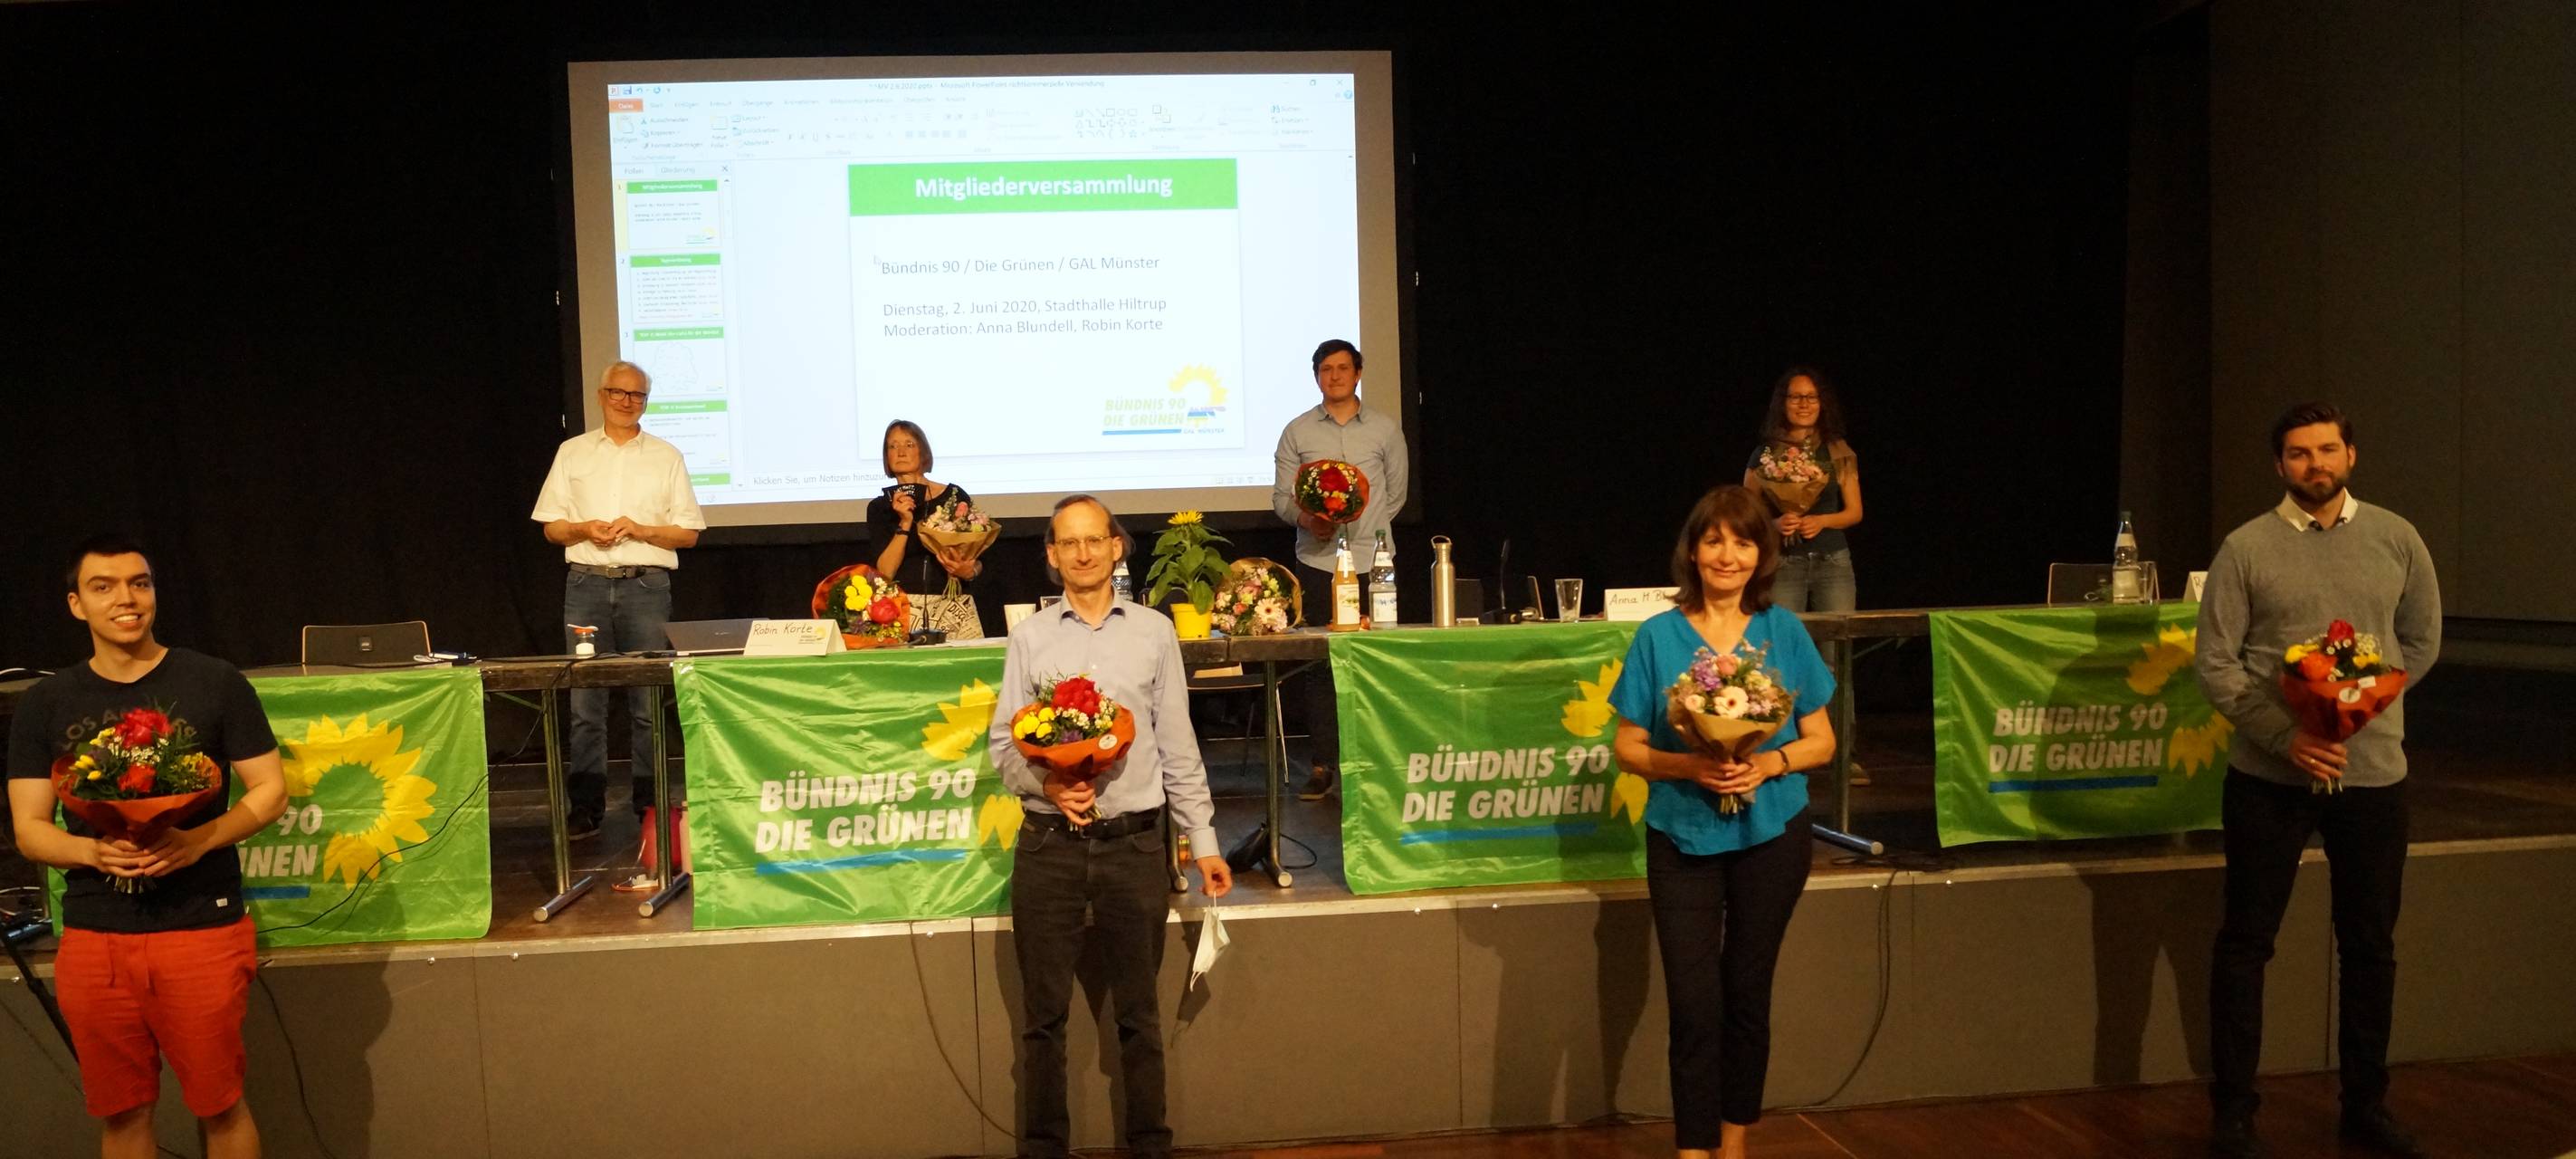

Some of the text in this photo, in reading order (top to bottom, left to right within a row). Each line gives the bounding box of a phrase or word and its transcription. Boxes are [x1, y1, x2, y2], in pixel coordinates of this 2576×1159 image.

[914, 174, 1173, 200] Mitgliederversammlung
[882, 255, 1160, 274] Bündnis 90 / Die Grünen / GAL Münster
[883, 298, 1167, 319] Dienstag, 2. Juni 2020, Stadthalle Hiltrup
[884, 318, 1164, 337] Moderation: Anna Blundell, Robin Korte
[1104, 397, 1187, 411] BÜNDNIS 90
[1102, 411, 1184, 426] DIE GRÜNEN
[753, 476, 783, 485] Klicken
[786, 475, 801, 485] Sie,
[819, 474, 851, 483] Notizen
[854, 473, 887, 482] hinzuzu
[1608, 593, 1638, 606] Anna
[753, 622, 813, 636] Robin Korte
[1993, 700, 2168, 736] BÜNDNIS 90
[1407, 743, 1610, 783] BÜNDNIS 90
[1989, 733, 2163, 772] DIE GRÜNEN
[759, 768, 977, 813] BÜNDNIS 90
[1402, 779, 1606, 823] DIE GRÜNEN
[276, 803, 323, 836] 90
[755, 803, 973, 854] DIE GRÜNEN
[238, 840, 319, 877] NEN
